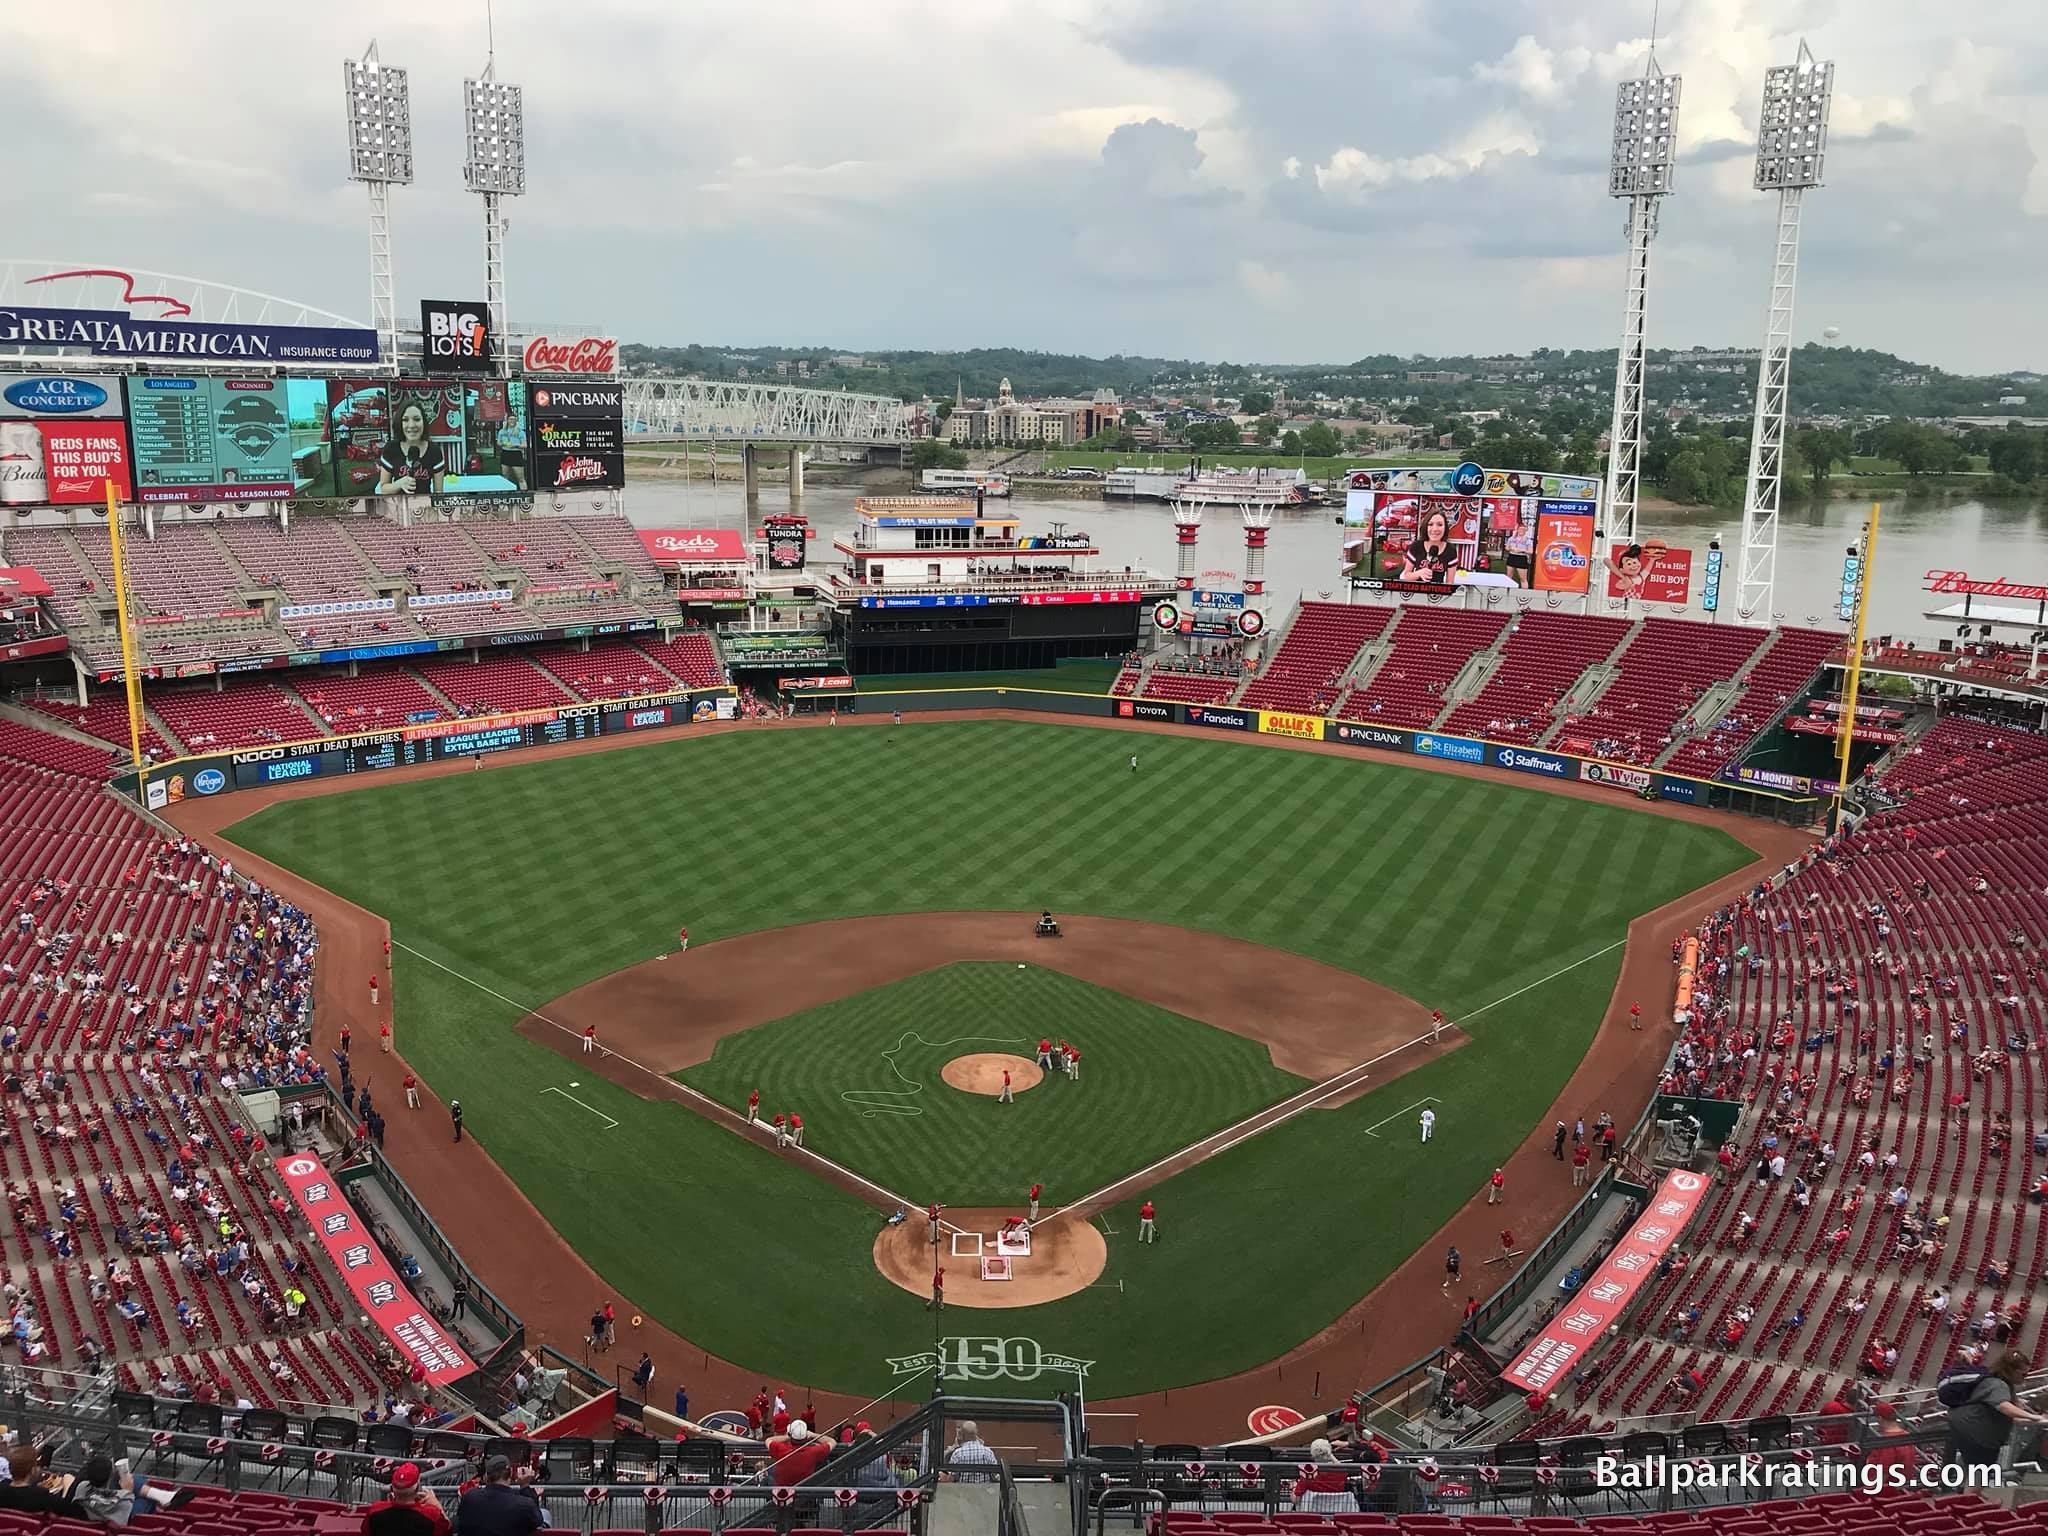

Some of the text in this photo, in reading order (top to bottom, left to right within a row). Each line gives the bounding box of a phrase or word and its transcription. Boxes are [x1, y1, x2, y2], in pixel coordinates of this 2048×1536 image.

[430, 312, 480, 337] BIG
[0, 311, 270, 357] GREAT AMERICAN
[280, 346, 373, 359] INSURANCE GROUP
[36, 381, 76, 394] ACR
[19, 396, 92, 407] CONCRETE
[552, 392, 620, 406] PNC BANK
[542, 431, 581, 441] DRAFT
[50, 438, 121, 451] REDS FANS,
[547, 439, 580, 448] KINGS
[51, 451, 121, 464] THIS BUD'S
[573, 456, 593, 468] John
[53, 465, 110, 478] FOR YOU.
[554, 461, 607, 485] Morrell
[1458, 473, 1482, 486] P&G
[1487, 478, 1506, 490] Tide
[144, 493, 189, 501] CELEBRATE
[240, 490, 269, 498] SEASON
[270, 489, 290, 497] LONG
[434, 497, 475, 508] ULTIMATE
[493, 497, 531, 506] SHUTTLE
[769, 530, 802, 538] TUNDRA
[655, 535, 719, 551] Reds
[1054, 539, 1089, 549] TriHealth
[1571, 559, 1586, 567] OXI
[1655, 561, 1667, 570] It's
[1353, 580, 1383, 589] NOCO
[1650, 575, 1687, 585] BIG BOY
[724, 590, 741, 599] PATIO
[1211, 593, 1236, 604] PNC
[490, 633, 543, 645] CINCINNATI
[349, 645, 415, 660] LOS ANGELES
[558, 706, 599, 719] NOCO
[603, 703, 627, 713] START
[629, 700, 649, 710] DEAD
[633, 709, 665, 720] AMERICAN
[1136, 706, 1168, 716] TOYOTA
[632, 715, 665, 726] LEAGUE
[1203, 711, 1244, 726] Fanatics
[407, 725, 454, 740] ULTRASAFE
[457, 721, 490, 733] LITHIUM
[491, 717, 513, 728] JUMP
[1266, 727, 1316, 739] BARGAIN OUTLET
[1852, 728, 1868, 738] UD'S
[1868, 731, 1882, 739] FOR
[446, 733, 479, 744] LEAGUE
[481, 727, 519, 740] LEADERS
[1350, 728, 1402, 745] PNC BANK
[233, 733, 402, 764] NOCO START DEAD BATTERIES.
[445, 741, 475, 752] EXTRA
[476, 737, 499, 748] BASE
[501, 734, 521, 745] HITS
[1443, 742, 1482, 757] Elizabeth
[268, 759, 311, 772] NATIONAL
[268, 767, 313, 780] LEAGUE
[1609, 768, 1648, 785] Wyler
[1753, 770, 1760, 779] A
[1761, 771, 1793, 786] MONTH
[198, 775, 224, 790] Kroger
[1671, 786, 1694, 796] DELTA
[325, 1212, 347, 1233] 1961
[344, 1245, 369, 1267] 1970
[1617, 1253, 1646, 1271] 1975
[368, 1281, 395, 1305] 1972
[1592, 1281, 1623, 1301] 1940
[1565, 1313, 1597, 1333] 1919
[394, 1322, 447, 1373] CHAMPIONS
[408, 1313, 465, 1369] NATIONAL LEAGUE
[903, 1336, 1081, 1381] EST. 150 1869
[1513, 1337, 1557, 1378] WORLD SERIES
[1526, 1342, 1577, 1388] CHAMPIONS
